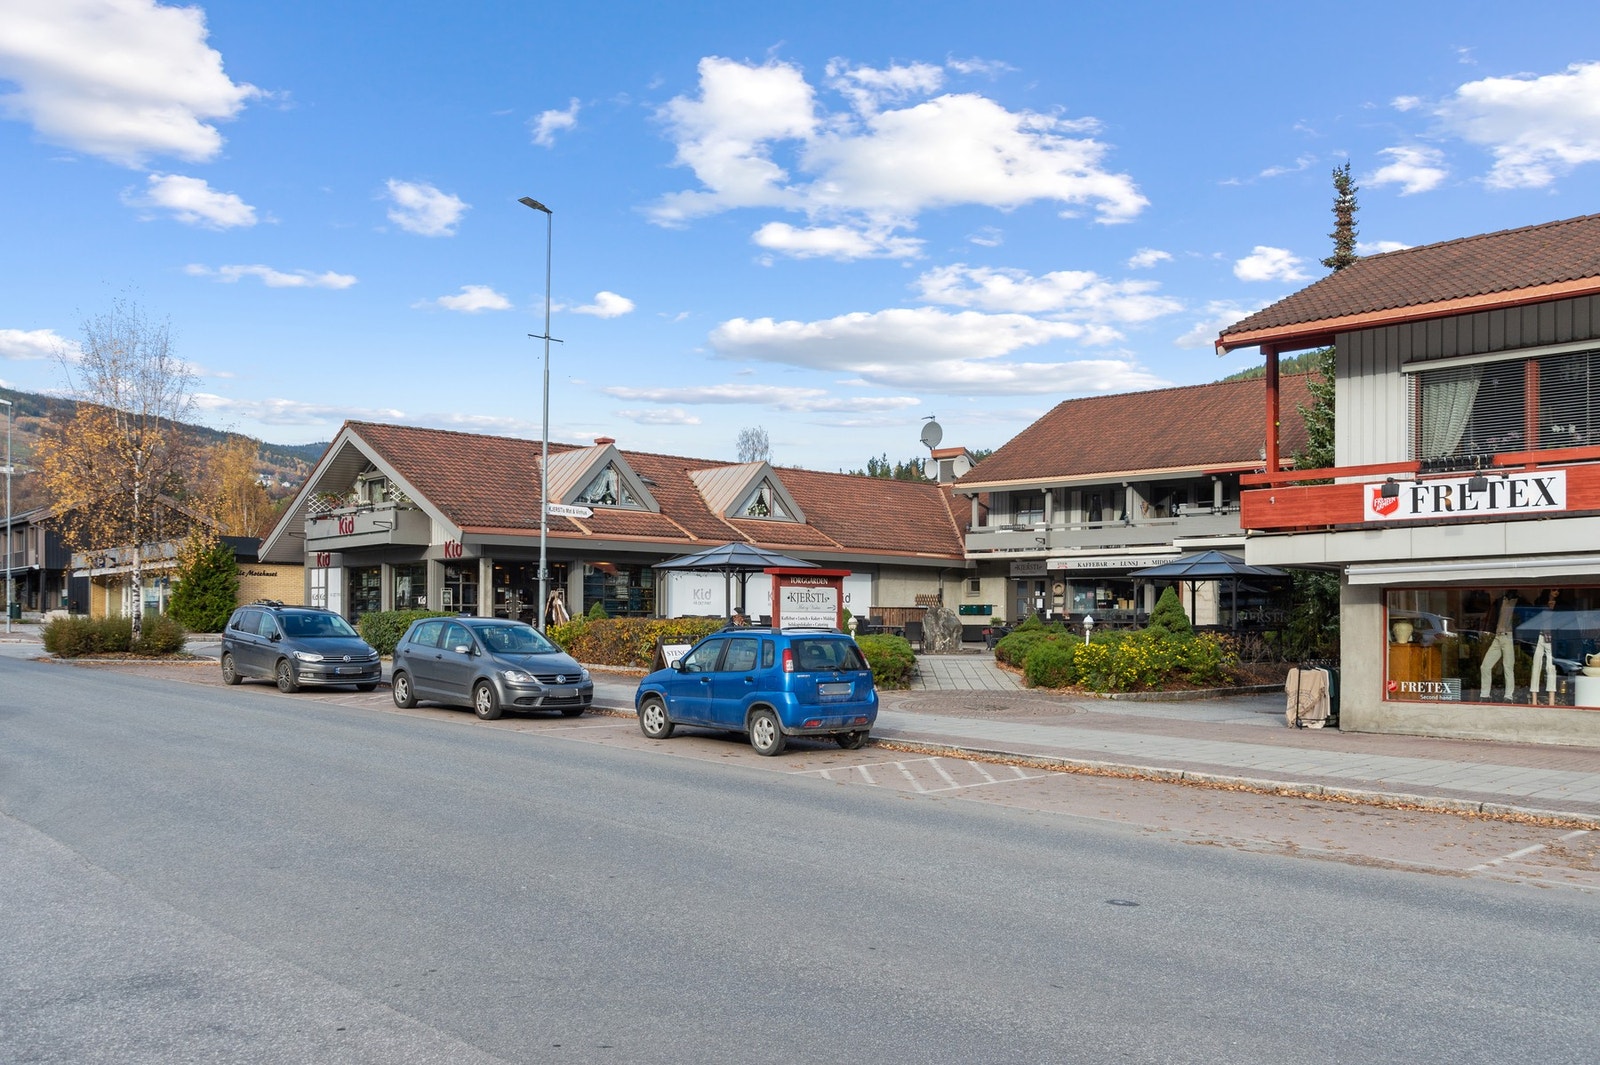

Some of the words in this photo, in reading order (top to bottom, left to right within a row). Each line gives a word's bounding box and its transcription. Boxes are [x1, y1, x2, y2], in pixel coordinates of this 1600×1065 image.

[1410, 477, 1558, 514] FRETEX
[339, 516, 355, 534] Kid
[445, 539, 463, 558] Kid
[317, 552, 331, 567] Kid
[693, 588, 712, 600] Kid
[1401, 681, 1452, 693] FRETEX
